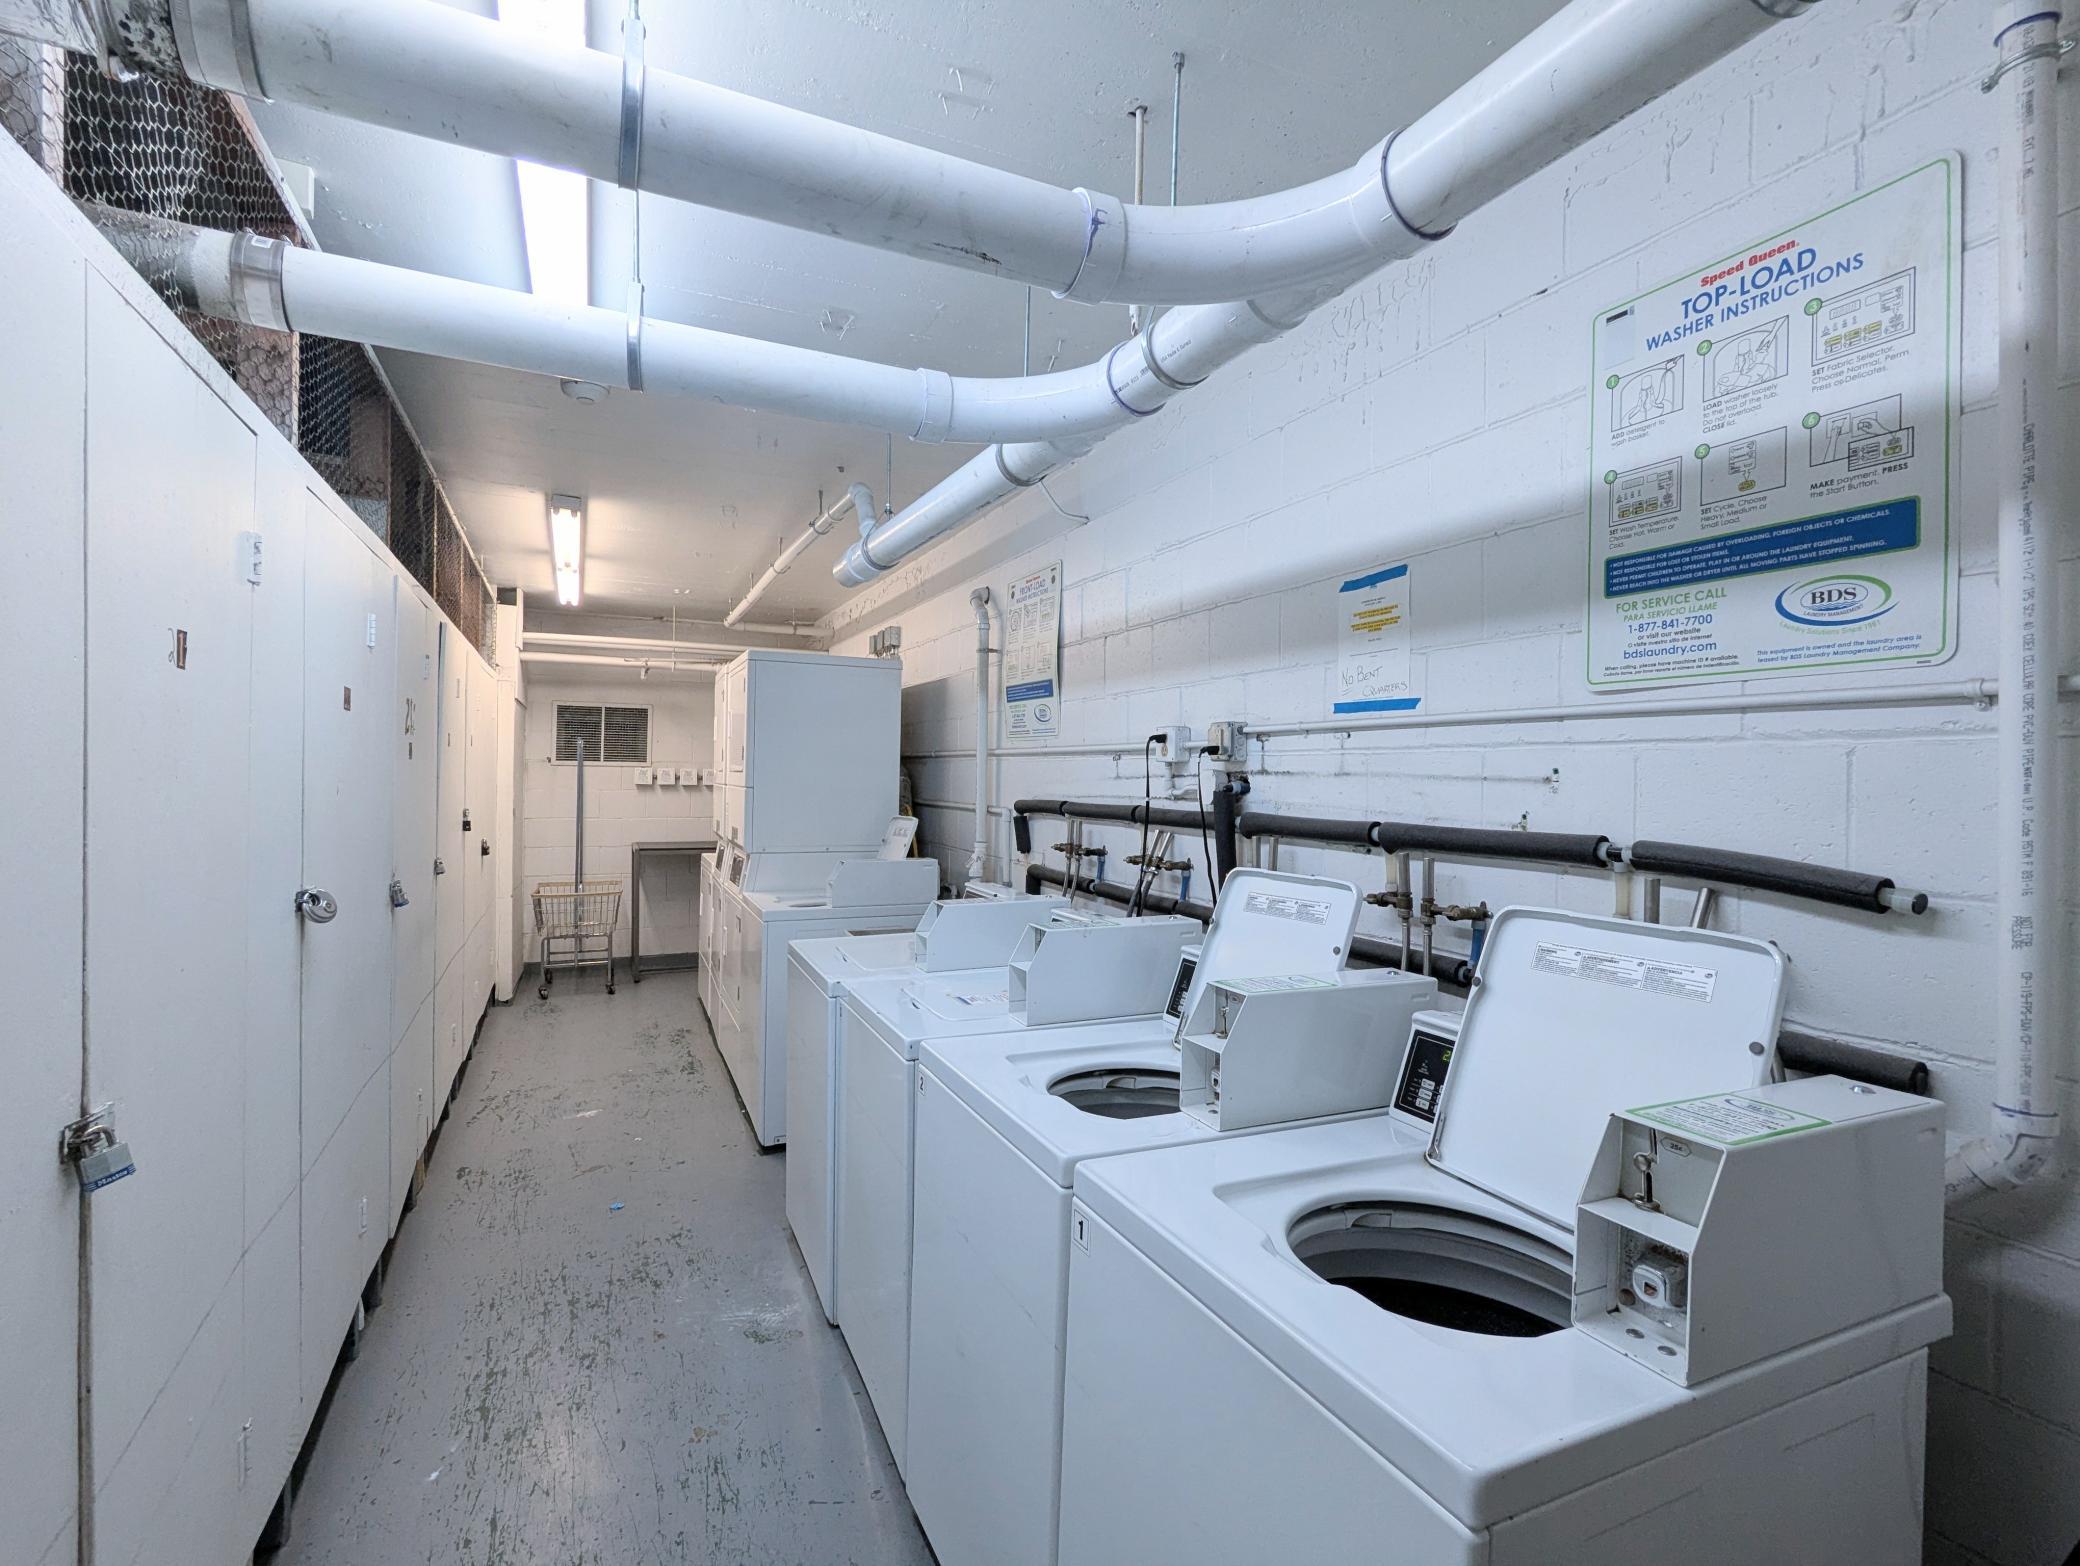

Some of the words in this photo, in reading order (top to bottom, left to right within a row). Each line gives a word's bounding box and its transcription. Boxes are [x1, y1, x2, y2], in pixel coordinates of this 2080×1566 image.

[1681, 244, 1816, 321] TOP-LOAD
[1700, 261, 1744, 288] Speed
[1646, 312, 1713, 352] WASHER
[1721, 251, 1863, 323] INSTRUCTIONS
[1812, 368, 1843, 385] Choose
[1885, 347, 1909, 362] Perm
[1812, 366, 1824, 377] SET
[1826, 357, 1854, 372] Fabric
[1703, 399, 1722, 411] LOAD
[1723, 390, 1750, 405] washer
[1752, 381, 1777, 397] loosely
[1811, 380, 1831, 393] Press
[1611, 431, 1624, 440] ADD
[1702, 421, 1725, 434] CLOSE
[1810, 478, 1834, 490] MAKE
[1882, 461, 1908, 474] PRESS
[1810, 489, 1823, 499] the
[1825, 485, 1845, 495] Start
[1701, 506, 1711, 515] SET
[1738, 494, 1766, 506] Choose
[1726, 504, 1757, 517] Medium
[1759, 502, 1766, 510] or
[1620, 524, 1636, 533] Wash
[1700, 520, 1718, 530] Small
[1624, 555, 1655, 565] RESPONSIBLE
[1693, 542, 1715, 552] CAUSED
[1773, 525, 1801, 536] FOREIGN
[1803, 519, 1832, 530] OBJECTS
[1624, 563, 1655, 574] RESPONSIBLE
[1648, 568, 1672, 577] CHILDREN
[1742, 550, 1767, 560] AROUND
[1782, 542, 1811, 553] LAUNDRY
[1671, 573, 1692, 581] WASHER
[1703, 568, 1720, 576] DRYER
[1750, 558, 1776, 568] MOVING
[1779, 554, 1797, 563] PARTS
[1799, 551, 1816, 559] HAVE
[1818, 545, 1847, 556] STOPPED
[1616, 600, 1638, 613] FOR
[1640, 592, 1690, 609] SERVICE
[1694, 586, 1727, 601] CALL
[1811, 586, 1856, 605] BDS
[1623, 612, 1644, 622] PARA
[1647, 606, 1685, 619] SERVICIO
[1689, 601, 1717, 613] LLAME
[1803, 608, 1826, 619] LAUNDRY
[1827, 603, 1863, 616] MANAGEMENT
[1628, 613, 1712, 634] 1-877-841-7700
[1674, 627, 1700, 635] website
[1623, 639, 1716, 660] bdslaundry.com
[1758, 655, 1778, 663] leased
[1803, 650, 1831, 660] Laundry
[1832, 646, 1880, 657] Management
[1769, 645, 1804, 656] equipment
[1813, 642, 1835, 651] owned
[1853, 639, 1864, 647] the
[1866, 637, 1892, 647] laundry
[1896, 635, 1913, 643] area
[1672, 657, 1696, 665] machine
